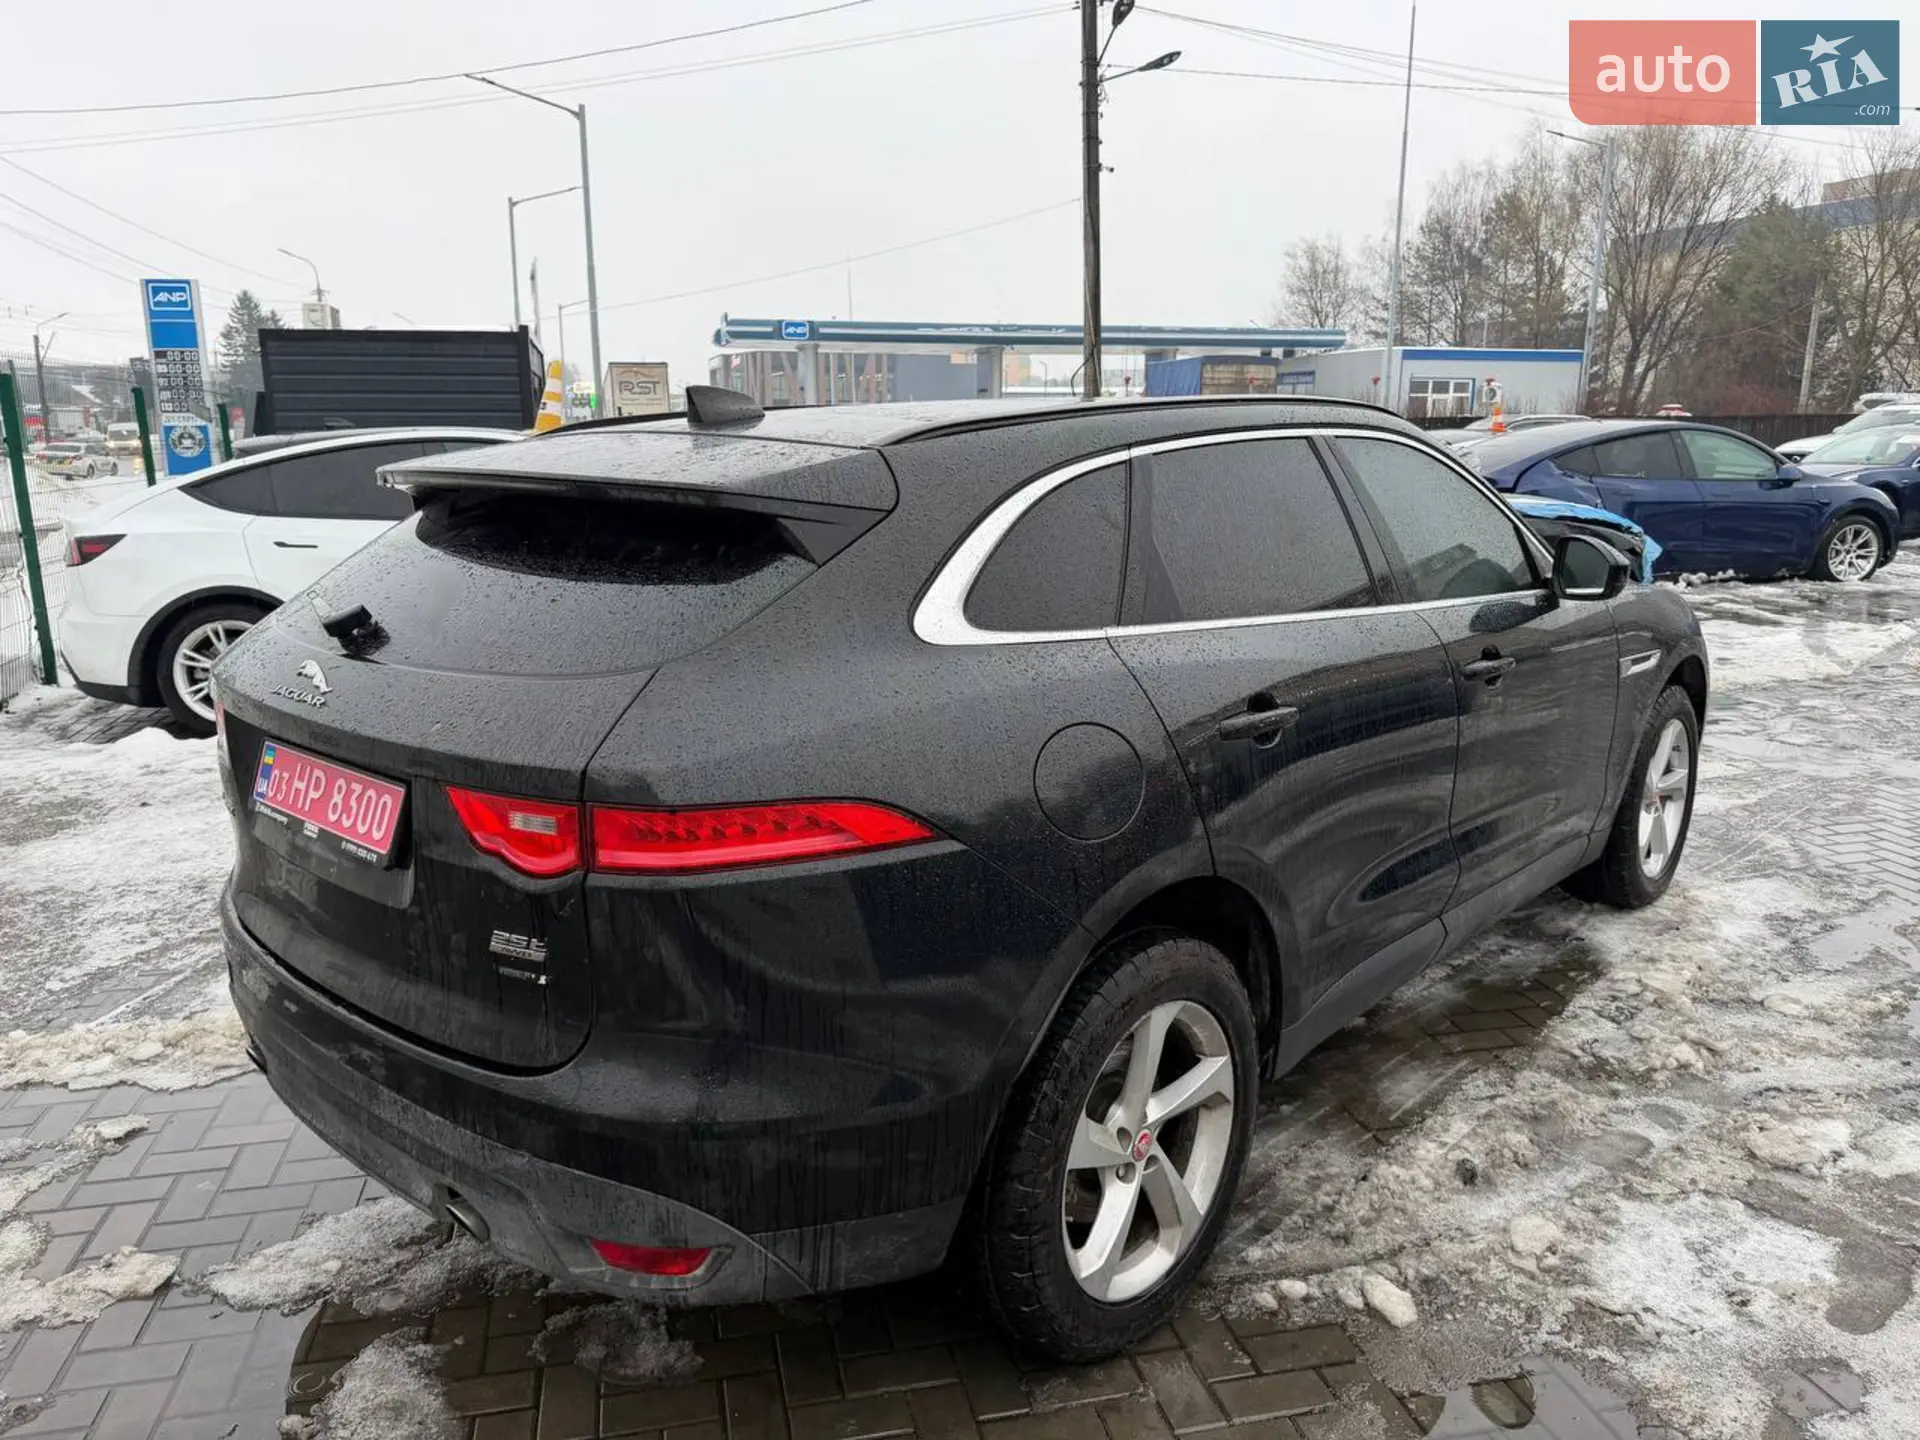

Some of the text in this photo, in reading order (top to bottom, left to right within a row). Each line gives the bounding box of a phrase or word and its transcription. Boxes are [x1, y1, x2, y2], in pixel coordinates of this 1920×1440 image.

[154, 291, 188, 303] ANP
[618, 380, 661, 396] RST
[268, 684, 327, 708] JAGUAR
[267, 769, 291, 801] 03
[288, 763, 327, 812] HP
[327, 777, 393, 841] 8300
